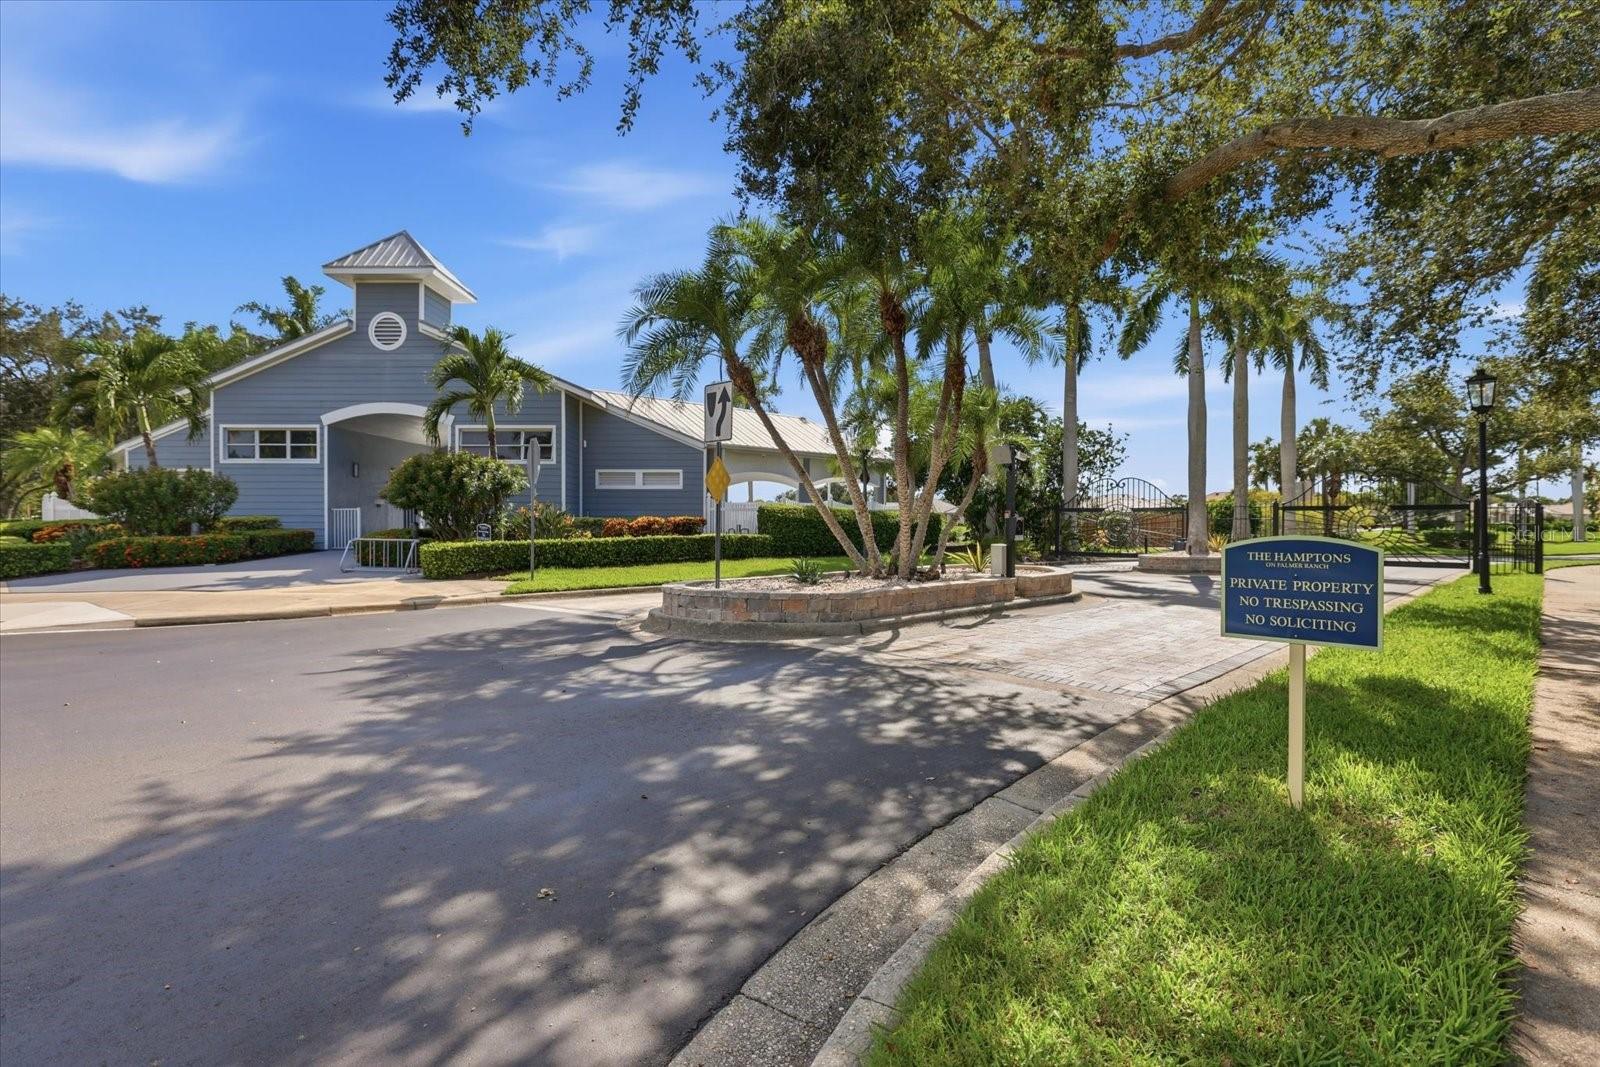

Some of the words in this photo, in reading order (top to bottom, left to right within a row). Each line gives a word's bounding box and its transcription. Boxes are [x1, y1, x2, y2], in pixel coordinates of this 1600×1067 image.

[1247, 552, 1271, 561] THE
[1274, 552, 1351, 563] HAMPTONS
[1229, 577, 1287, 591] PRIVATE
[1293, 580, 1374, 595] PROPERTY
[1239, 596, 1259, 607] NO
[1263, 597, 1363, 613] TRESPASSING
[1245, 614, 1265, 625] NO
[1270, 615, 1356, 632] SOLICITING
